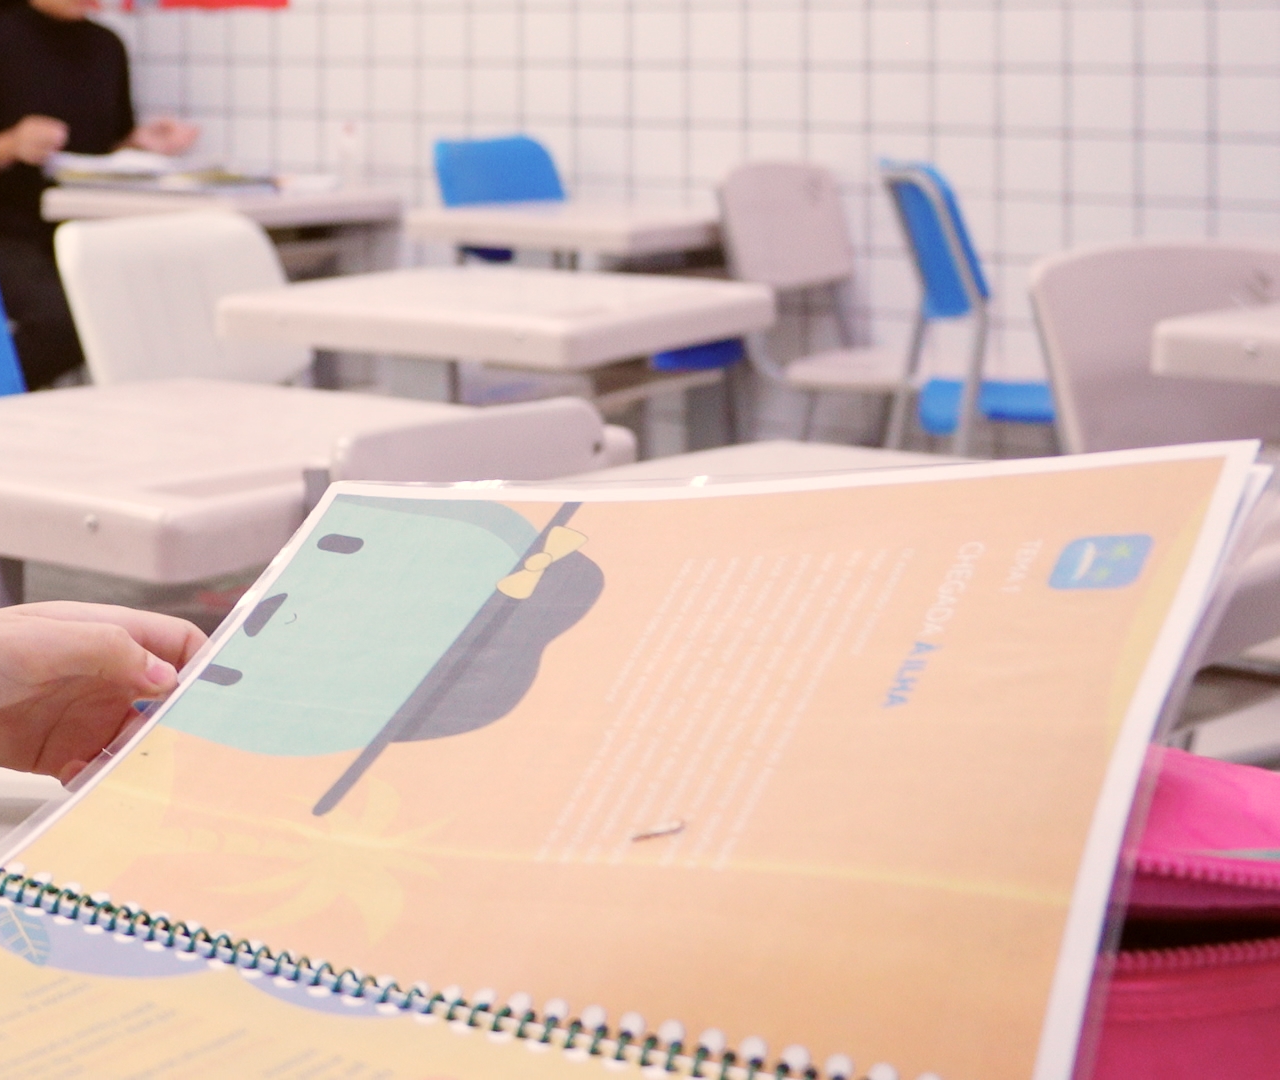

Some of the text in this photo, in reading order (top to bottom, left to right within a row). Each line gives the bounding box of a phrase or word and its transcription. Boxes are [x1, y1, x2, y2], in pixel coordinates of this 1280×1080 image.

[1004, 538, 1043, 583] TEMA
[918, 540, 985, 637] CHEGADA
[880, 659, 928, 709] ILHA
